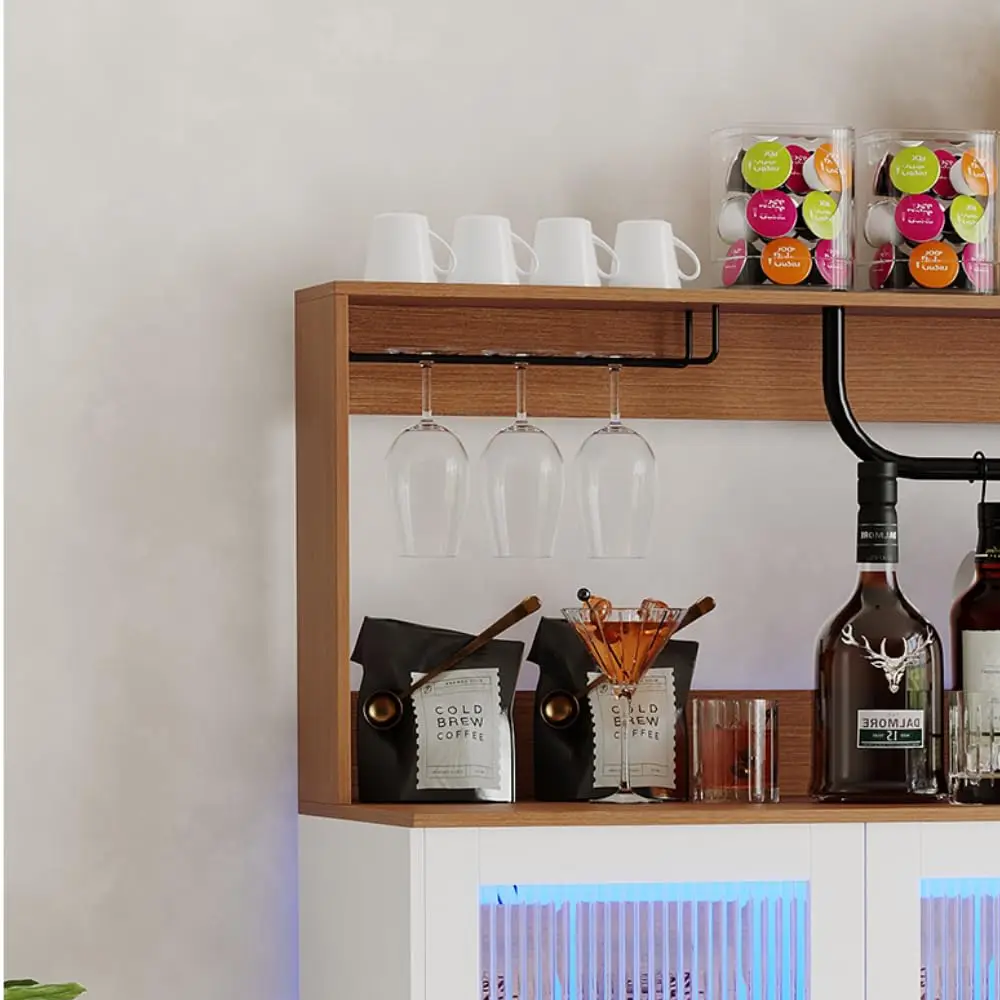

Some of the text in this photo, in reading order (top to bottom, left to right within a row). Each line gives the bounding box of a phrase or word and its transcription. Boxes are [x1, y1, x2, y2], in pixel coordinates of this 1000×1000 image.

[435, 704, 483, 715] COLD
[437, 716, 484, 728] BREW
[436, 730, 484, 742] COFFEE
[613, 729, 660, 741] CFFEE
